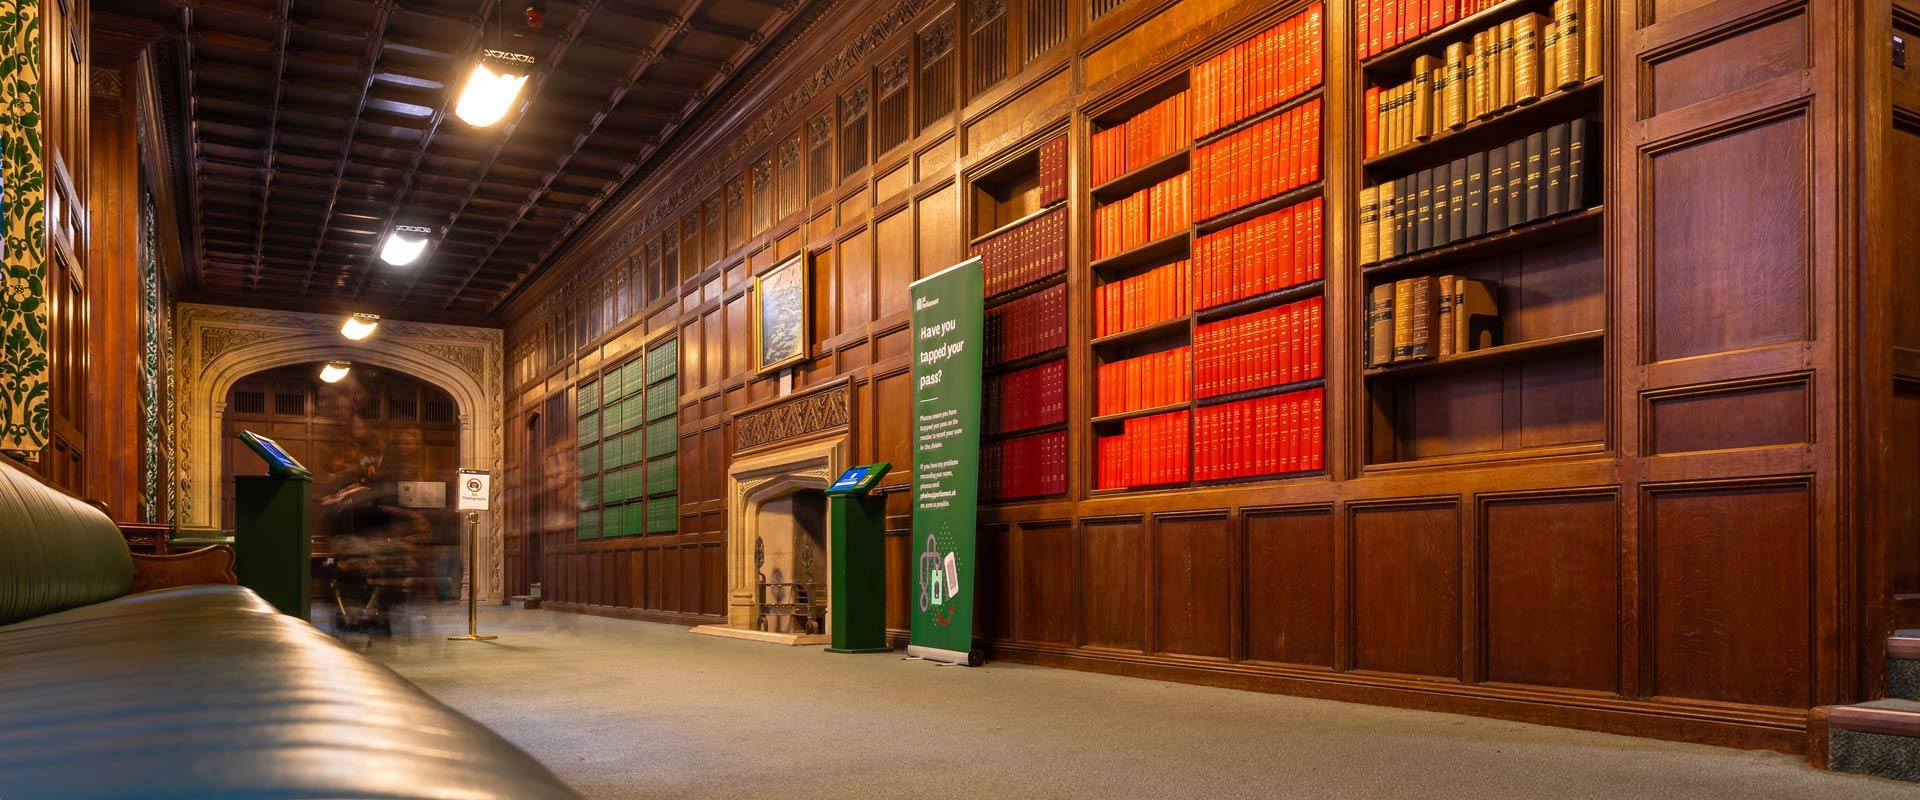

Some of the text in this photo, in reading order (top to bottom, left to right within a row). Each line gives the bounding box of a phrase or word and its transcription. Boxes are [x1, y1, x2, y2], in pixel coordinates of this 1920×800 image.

[920, 319, 956, 340] Have you
[920, 340, 964, 364] tapped your
[920, 369, 942, 390] pass?
